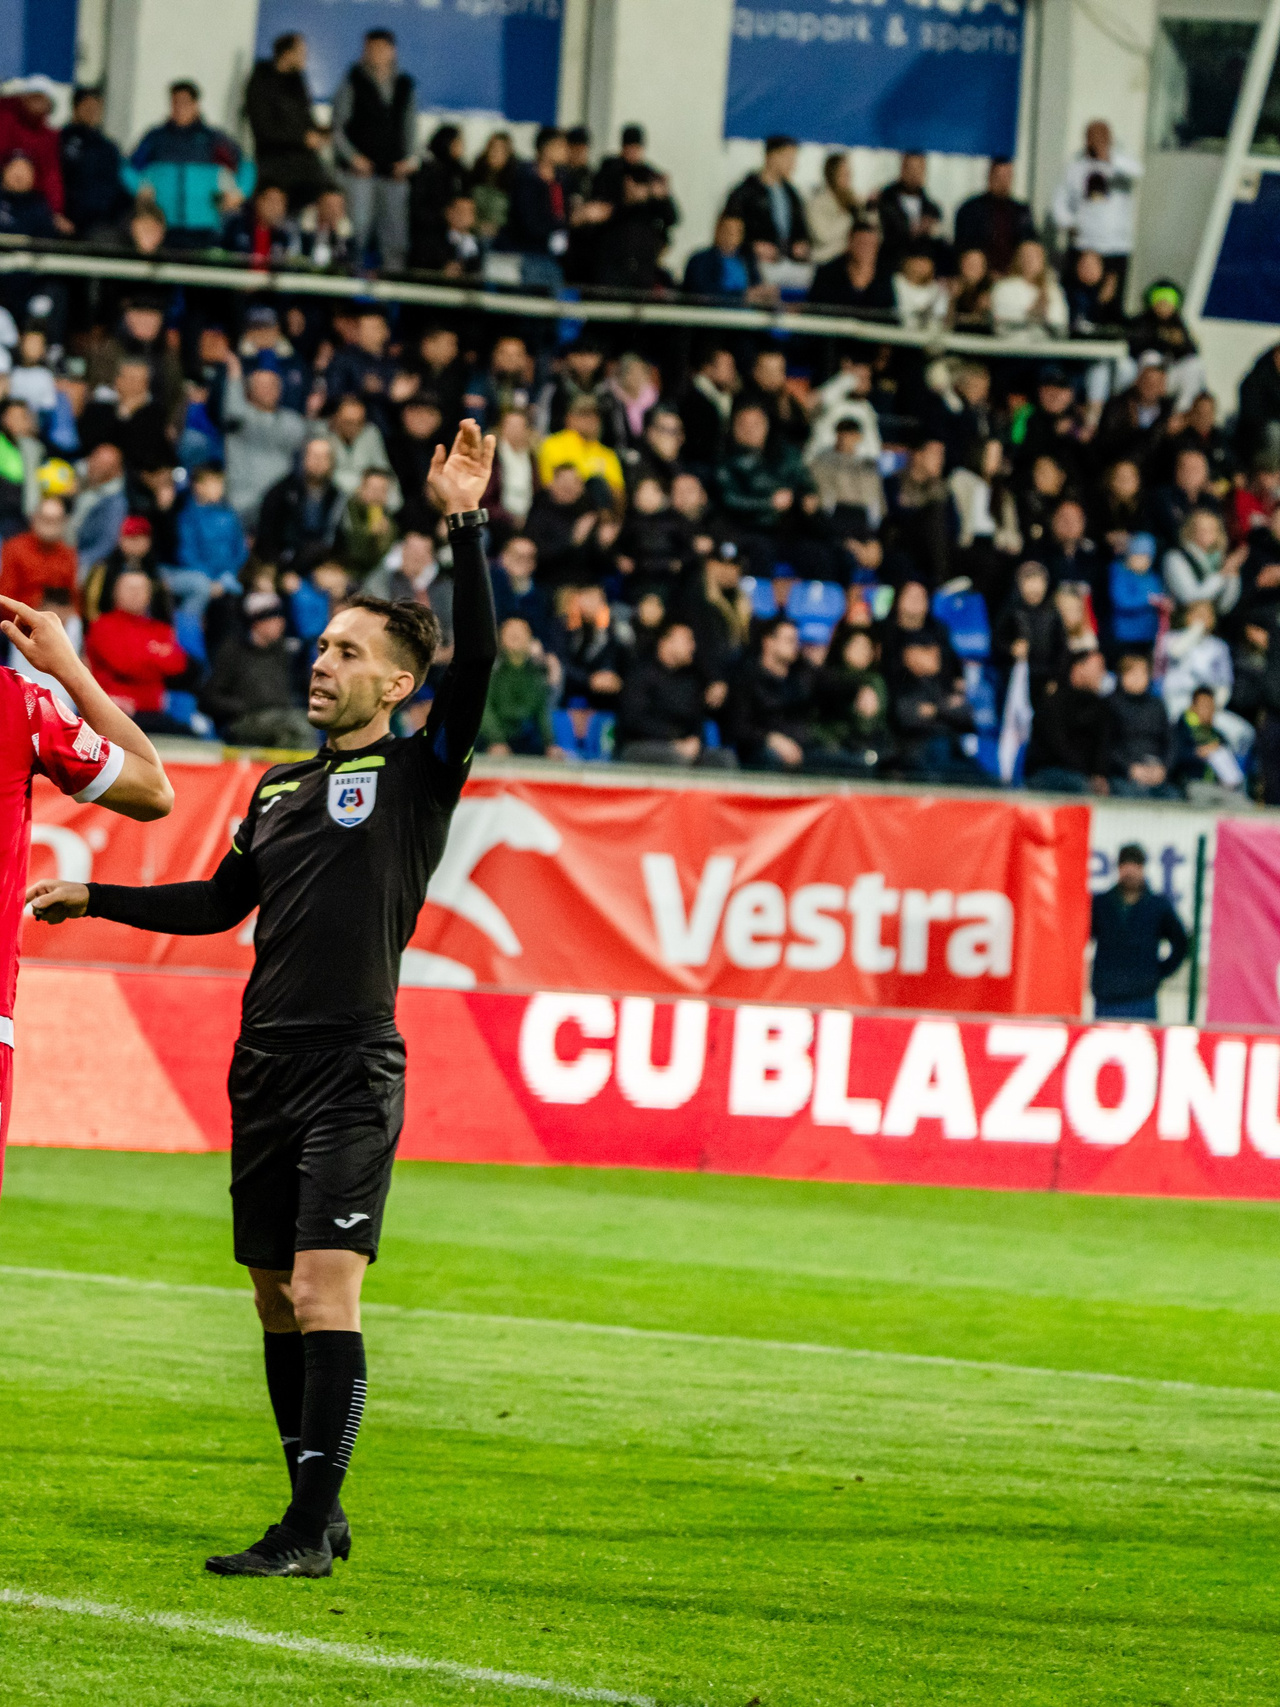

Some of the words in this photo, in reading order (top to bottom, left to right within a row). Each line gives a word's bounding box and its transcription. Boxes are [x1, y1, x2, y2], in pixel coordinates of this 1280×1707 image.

[922, 21, 1017, 54] sports
[335, 776, 372, 786] ARBITRU
[640, 851, 1015, 978] Vestra
[518, 990, 710, 1110] CU
